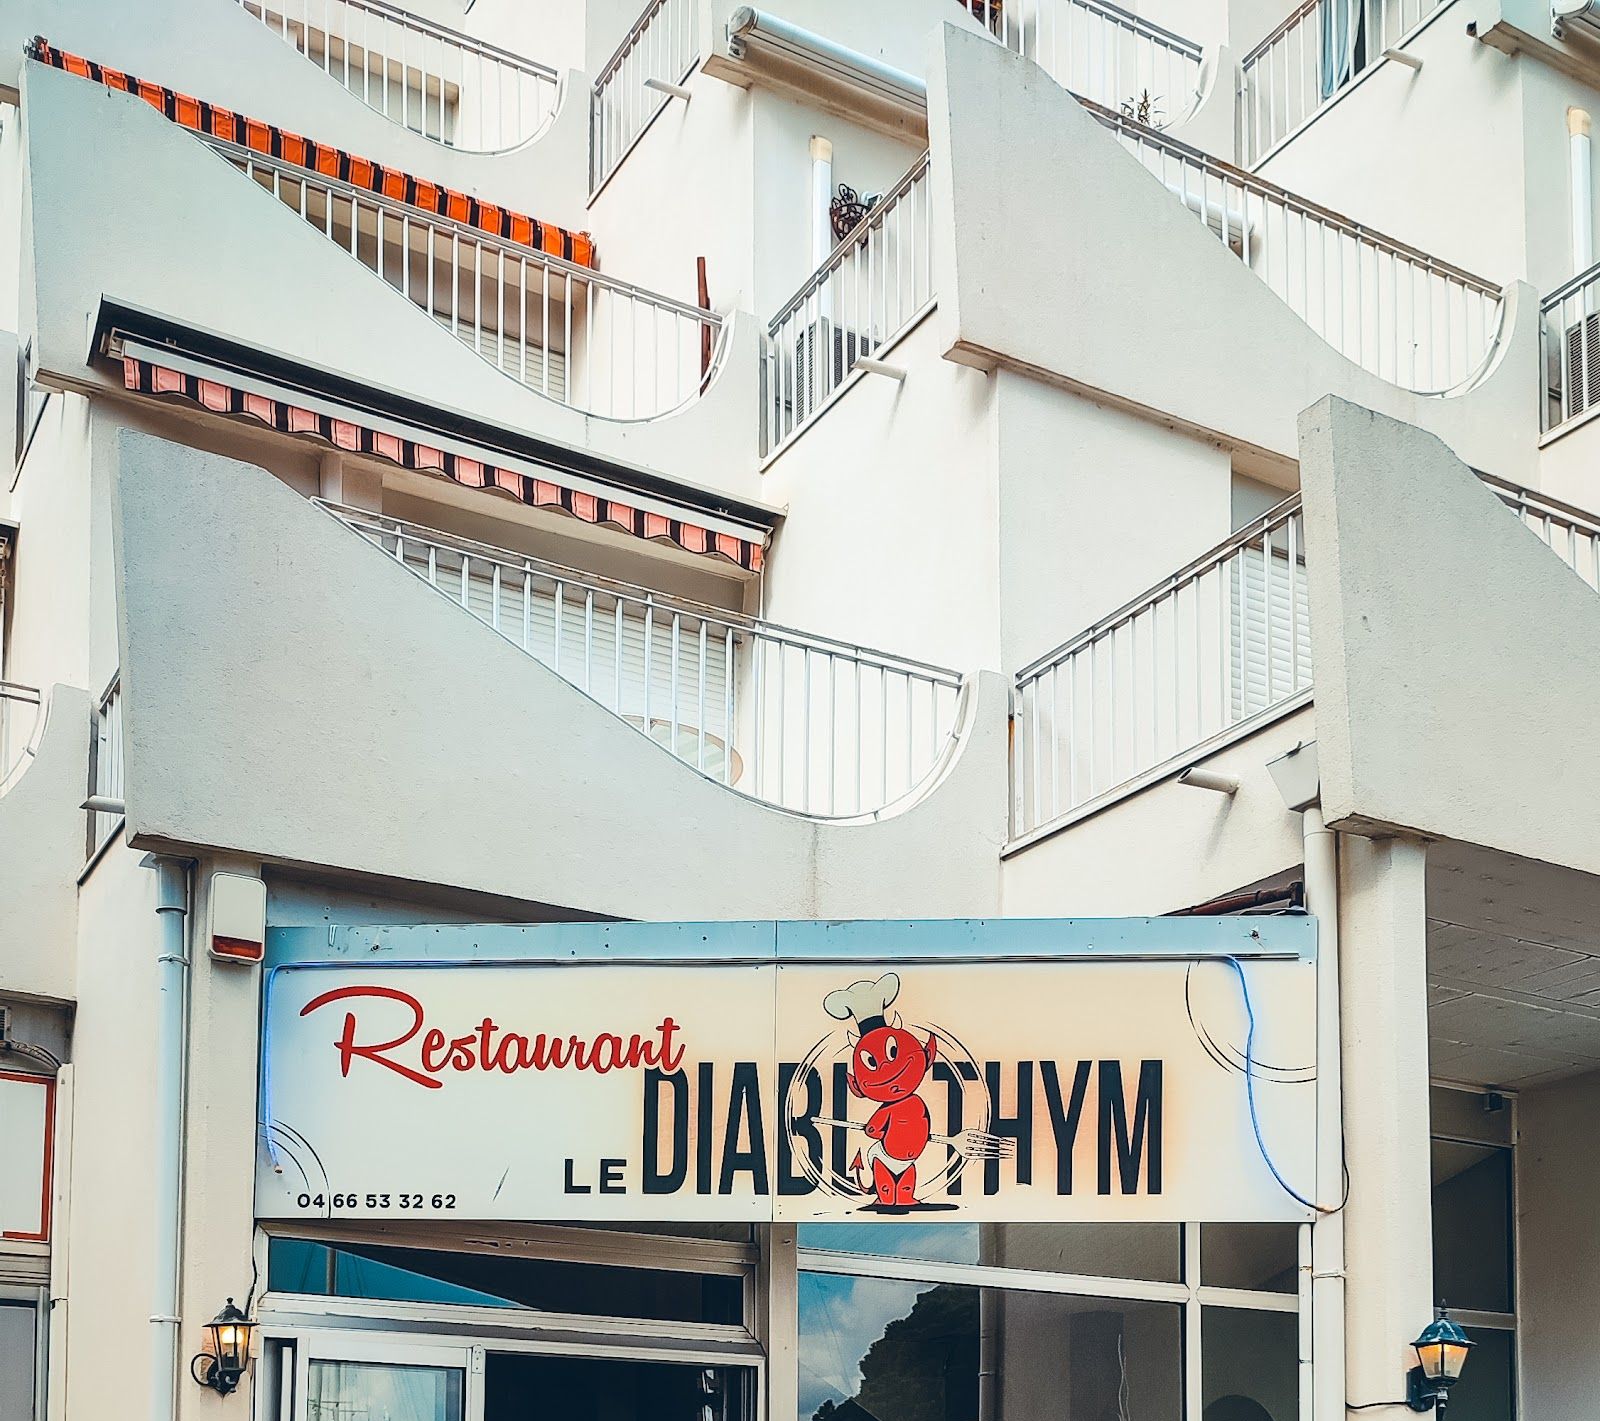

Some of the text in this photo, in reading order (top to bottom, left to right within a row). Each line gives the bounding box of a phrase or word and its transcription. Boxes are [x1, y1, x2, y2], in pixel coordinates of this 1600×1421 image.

[300, 986, 685, 1089] Restaurant
[564, 1059, 1163, 1197] LE DIABLTHYM
[297, 1193, 456, 1209] 04 66 53 32 62
